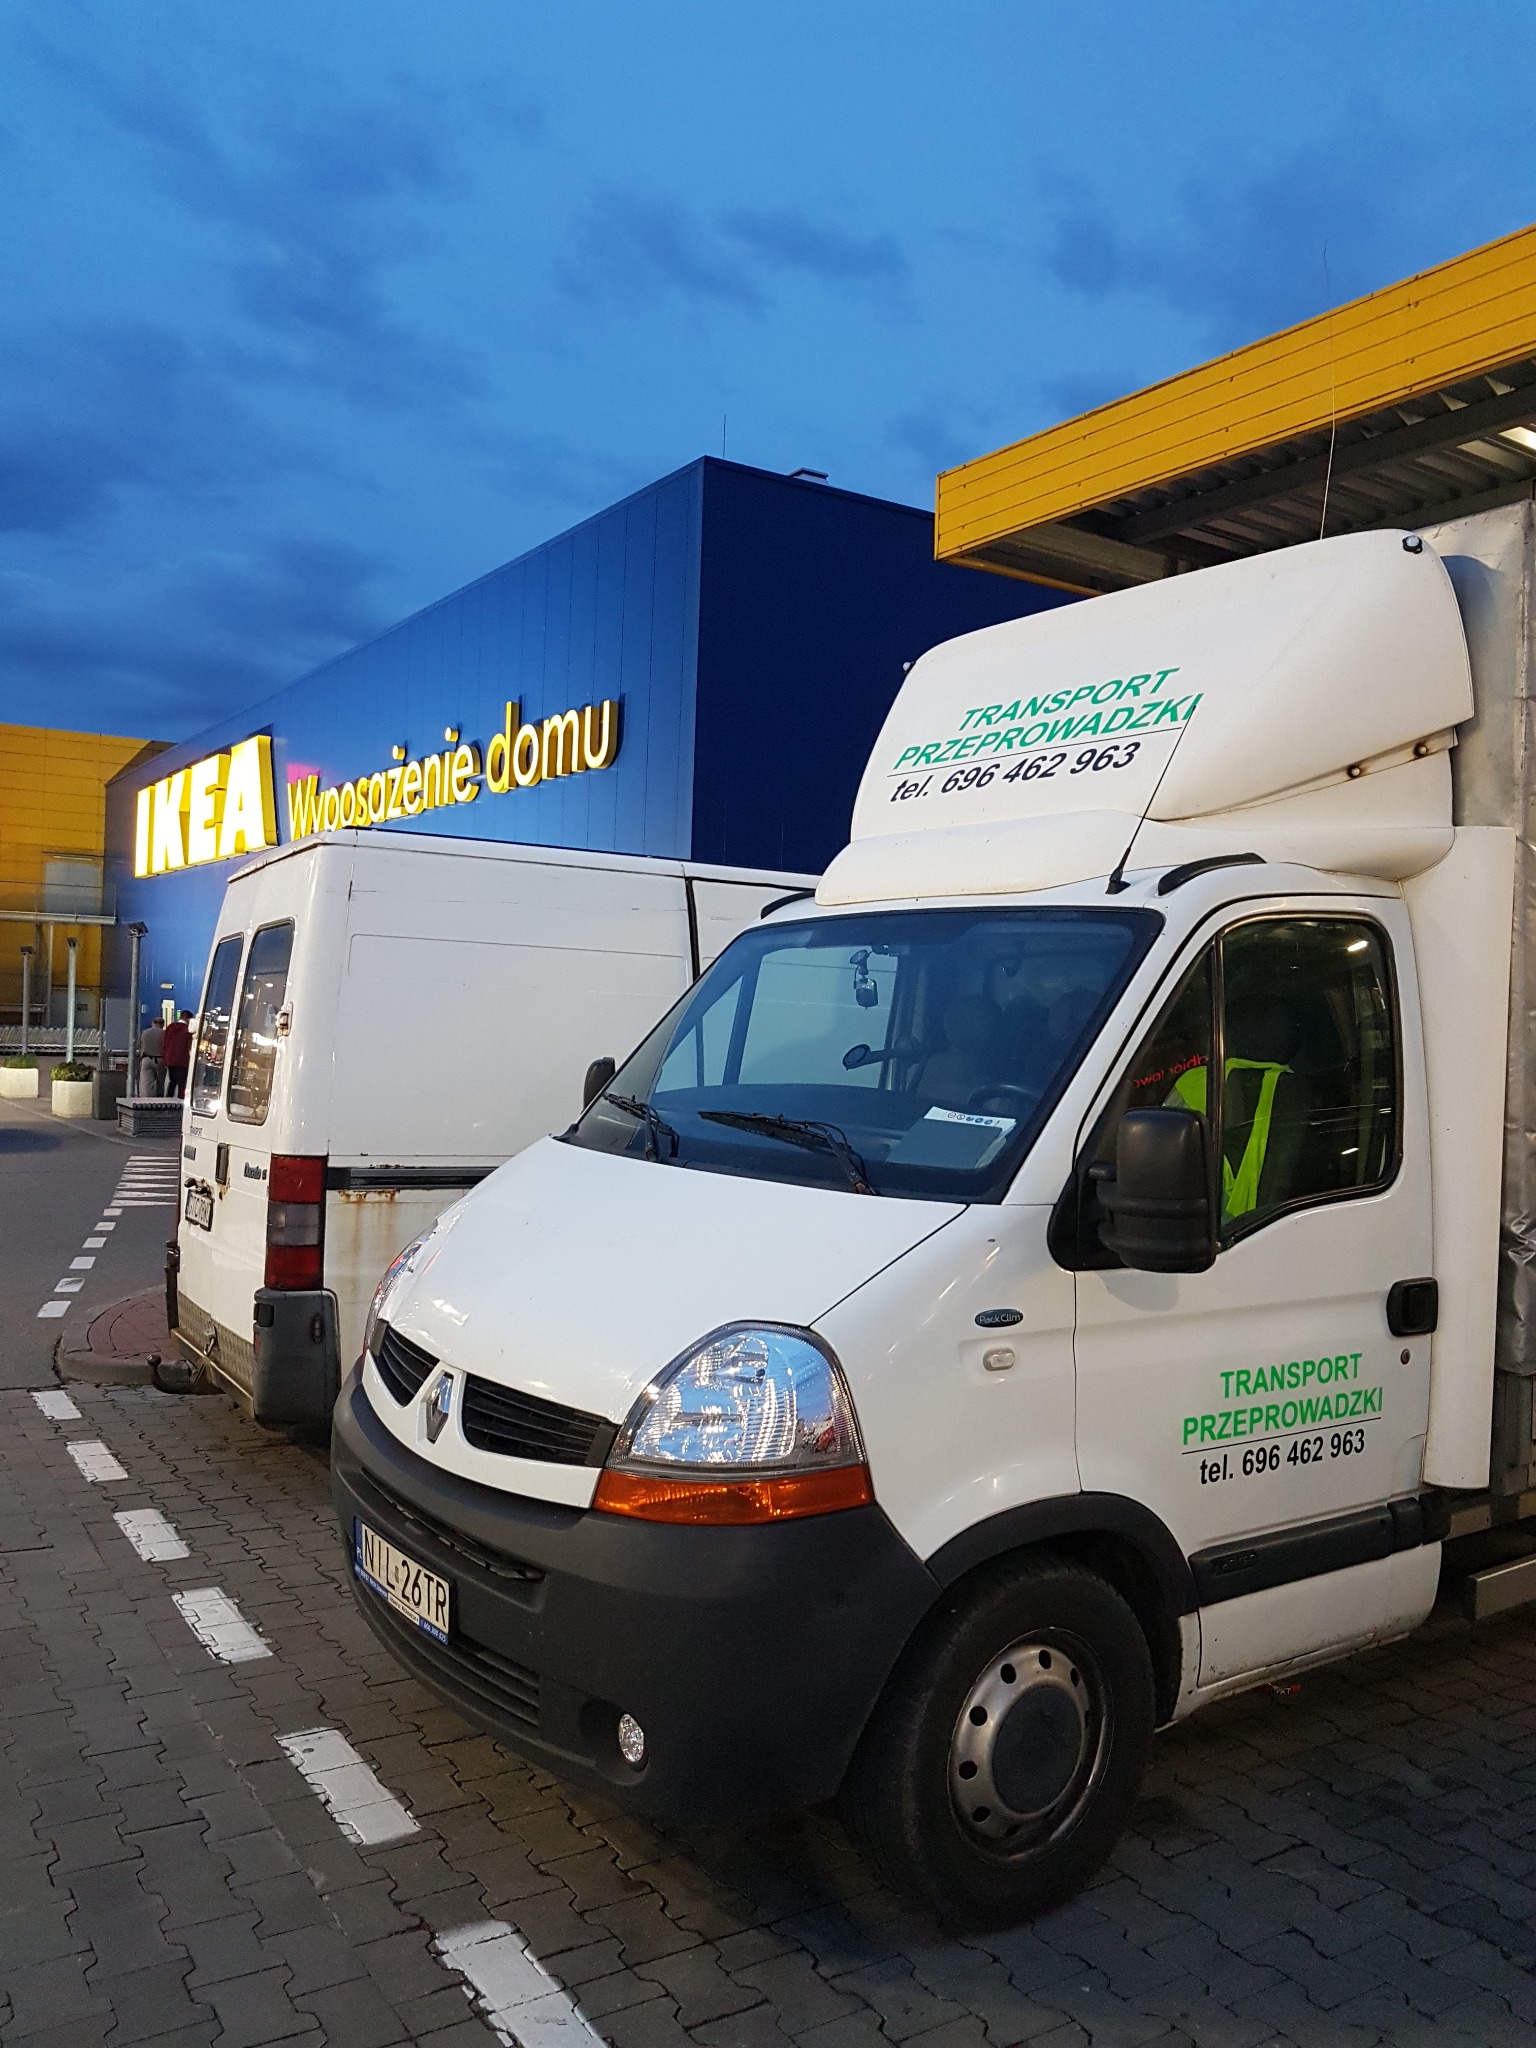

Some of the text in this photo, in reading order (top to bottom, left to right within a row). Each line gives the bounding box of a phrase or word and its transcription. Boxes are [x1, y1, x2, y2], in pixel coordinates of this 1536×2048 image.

[959, 667, 1181, 731] TRANSPORT
[893, 693, 1204, 770] PRZEPROWADZKI
[287, 700, 618, 842] Wyposażenie domu
[890, 741, 1141, 802] tel. 696 462 963
[135, 735, 277, 879] IKEA
[1220, 1353, 1363, 1398] TRANSPORT
[1183, 1387, 1383, 1445] PRZEPROWADZKI
[1200, 1428, 1365, 1484] tel. 696 462 963
